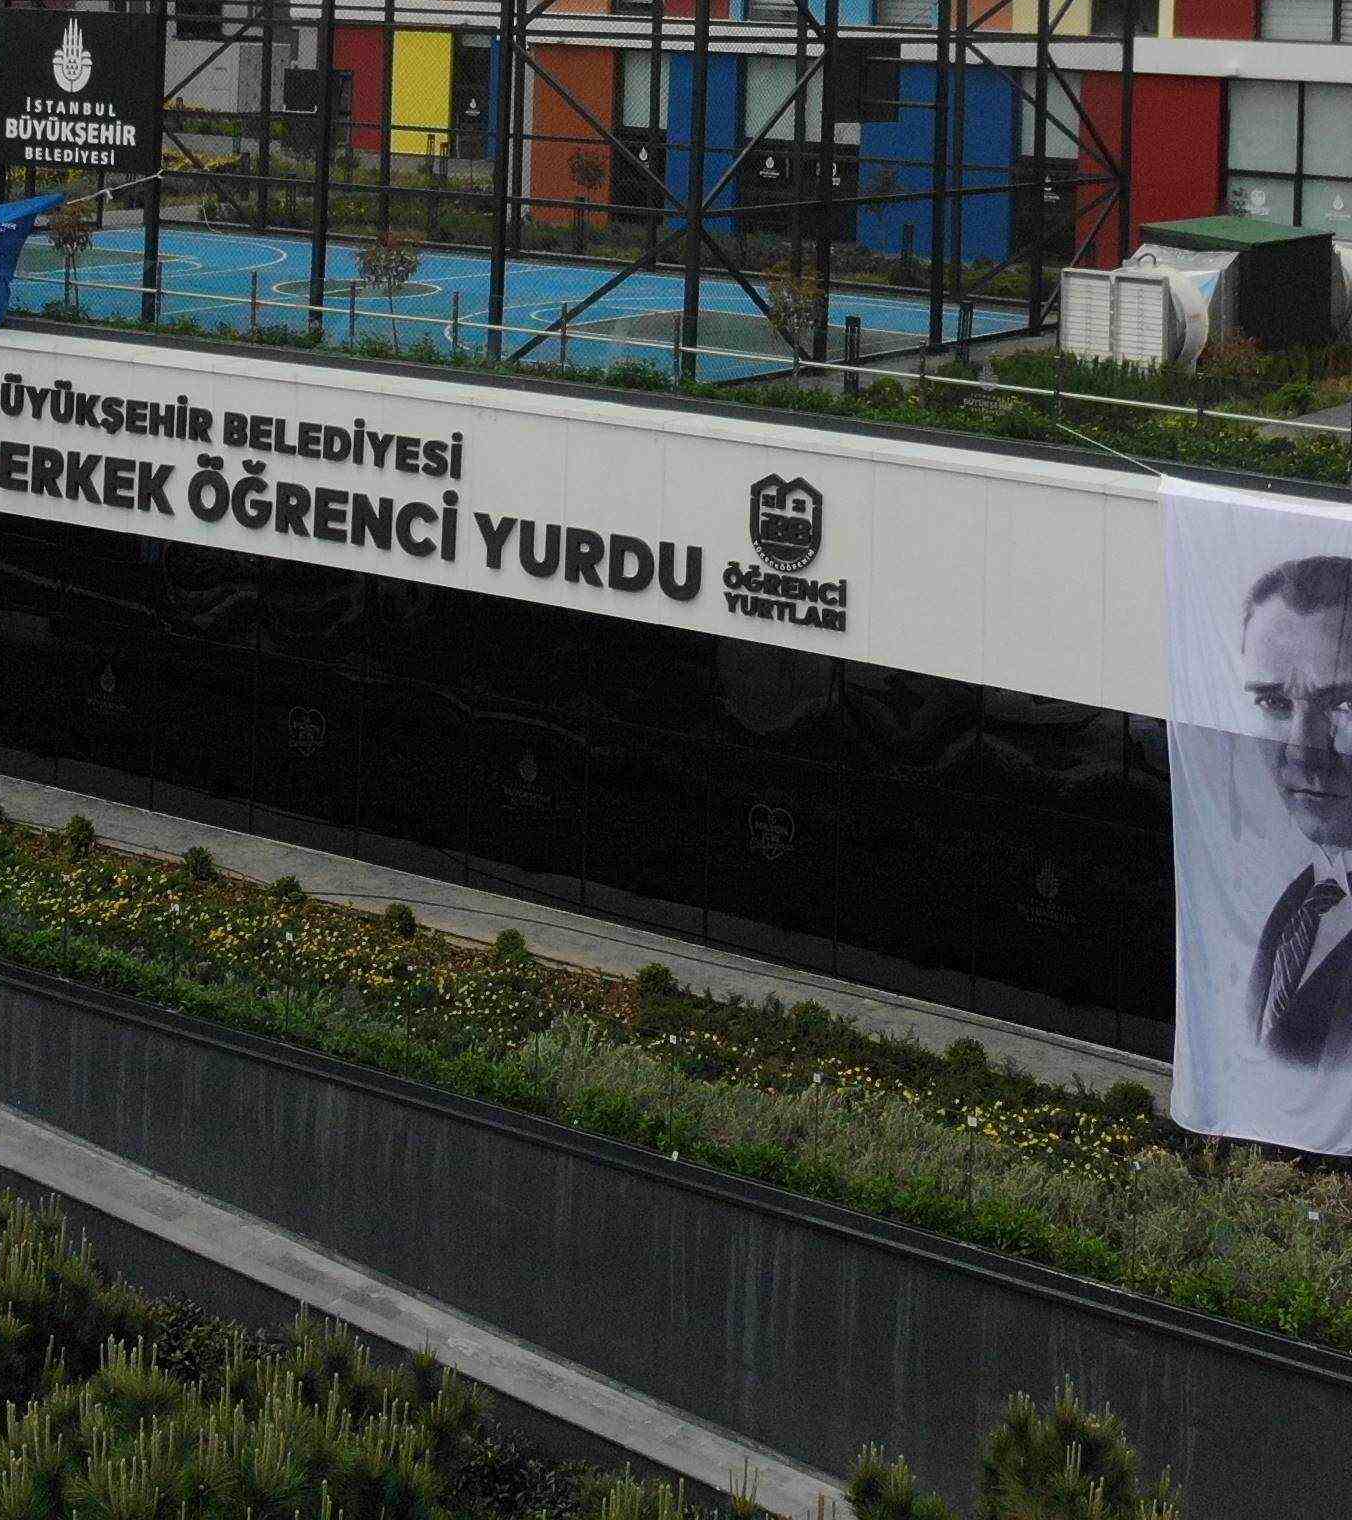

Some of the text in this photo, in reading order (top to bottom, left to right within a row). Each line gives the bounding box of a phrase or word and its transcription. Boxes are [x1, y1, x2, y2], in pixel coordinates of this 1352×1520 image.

[26, 96, 116, 117] İSTANBUL
[5, 115, 136, 147] BÜYÜKŞEHİR
[25, 146, 115, 166] BELEDİYESİ
[223, 410, 463, 480] BELEDİYESİ
[188, 452, 460, 562] ÖĞRENCİ
[473, 511, 703, 602] YURDU
[723, 560, 847, 608] ÖĞRENCİ
[724, 591, 847, 632] YURTLARI
